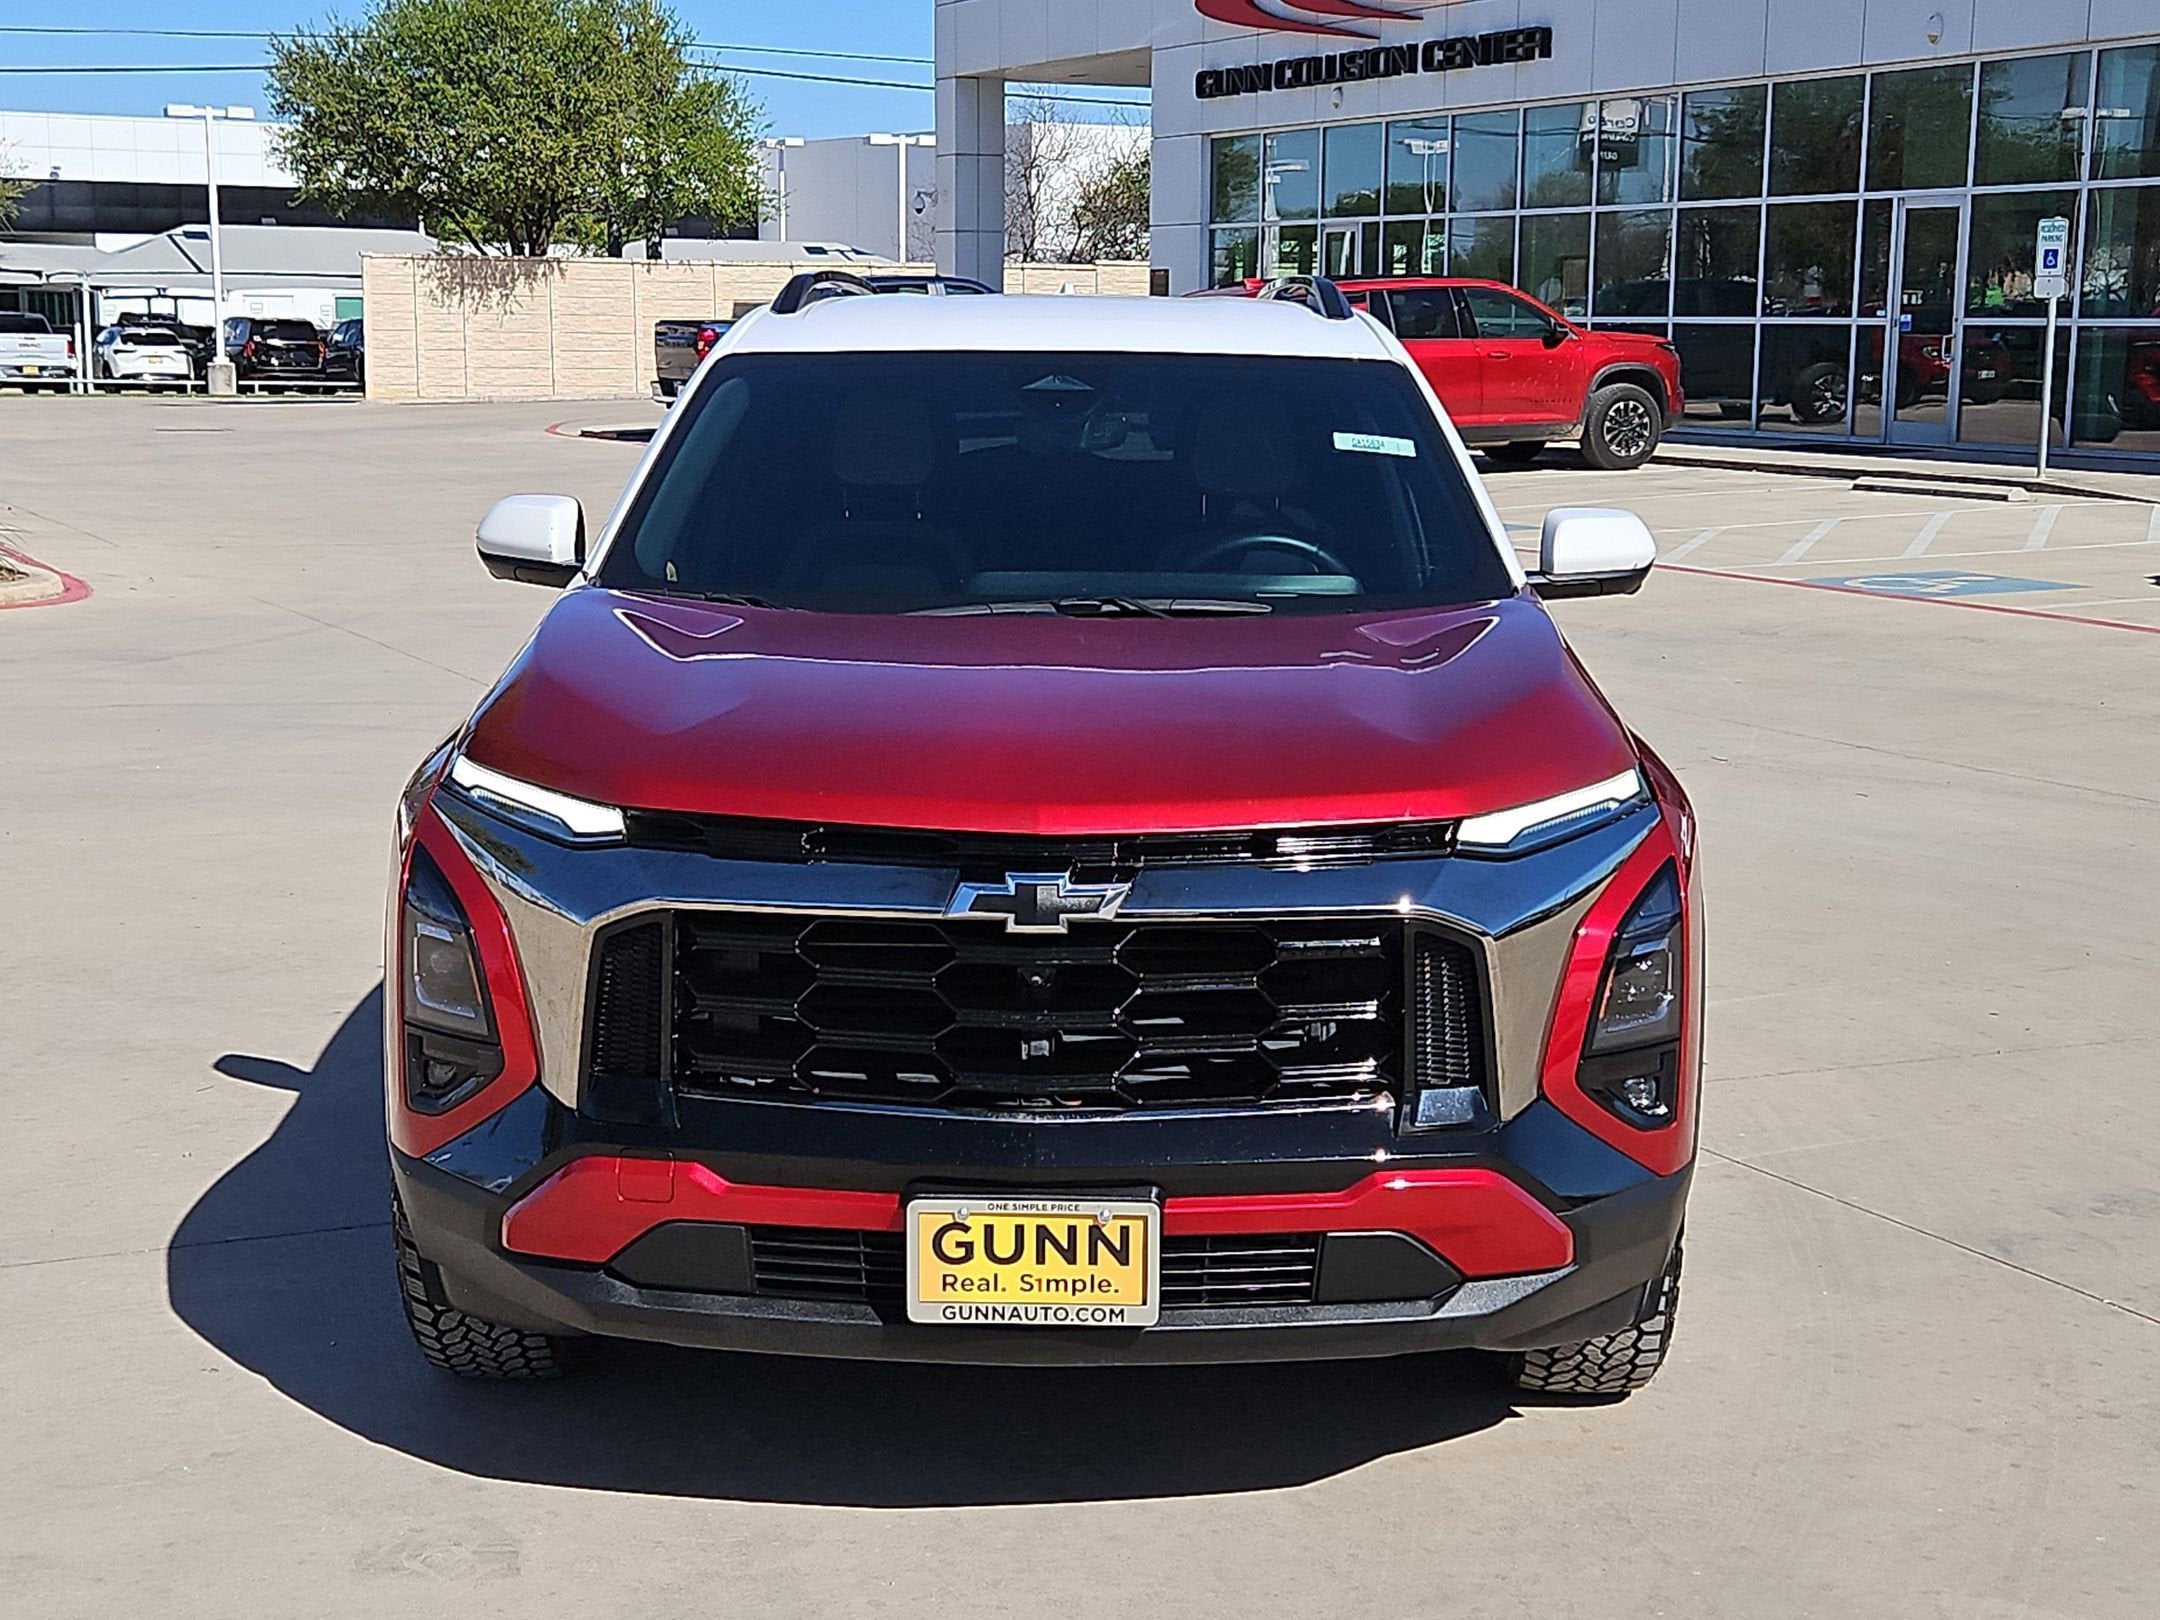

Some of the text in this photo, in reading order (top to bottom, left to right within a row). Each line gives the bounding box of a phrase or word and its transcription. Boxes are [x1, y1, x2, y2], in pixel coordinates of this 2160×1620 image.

[1195, 26, 1552, 99] GUNN COLLISION CENTER
[987, 1202, 1081, 1212] ONE SIMPLE PRICE
[931, 1221, 1131, 1266] GUNN
[942, 1273, 1007, 1292] Real.
[942, 1305, 1125, 1323] GUNNAUTO.COM
